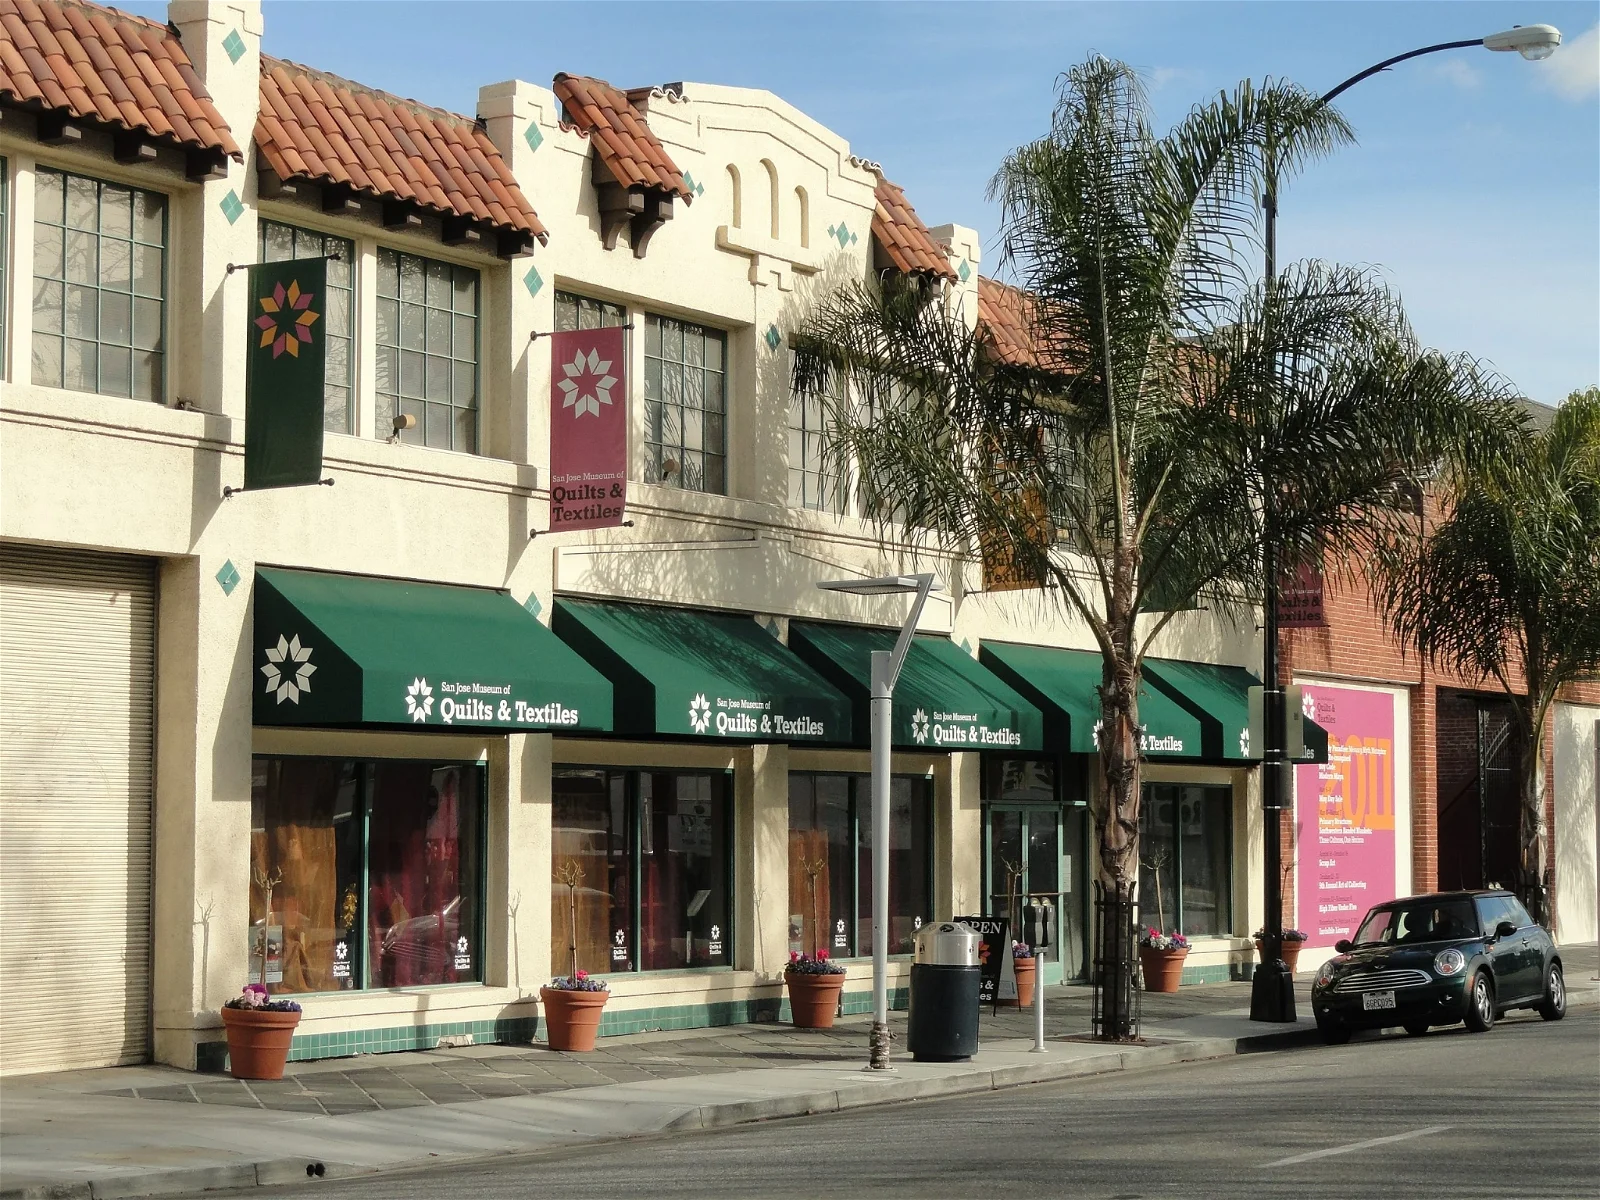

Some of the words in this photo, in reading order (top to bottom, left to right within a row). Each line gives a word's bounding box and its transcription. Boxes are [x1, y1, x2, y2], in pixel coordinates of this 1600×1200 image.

[566, 474, 581, 483] Jose
[582, 472, 615, 480] Museum
[552, 484, 606, 504] Quilts
[610, 483, 623, 498] &
[552, 504, 621, 522] Textiles
[1279, 610, 1322, 622] extiles
[441, 682, 454, 692] San
[456, 682, 470, 694] Jose
[472, 684, 502, 694] Museum
[503, 685, 512, 694] of
[440, 698, 493, 724] Quilts
[497, 700, 511, 722] &
[515, 701, 578, 724] Textiles
[717, 698, 728, 706] San
[728, 698, 740, 709] Jose
[741, 700, 764, 709] Museum
[765, 701, 770, 710] of
[716, 712, 757, 735] Quilts
[760, 714, 772, 733] &
[774, 716, 824, 736] Textiles
[933, 724, 966, 744] Quilts
[968, 726, 978, 742] &
[980, 726, 1020, 745] Textiles
[1140, 734, 1148, 750] &
[1148, 736, 1182, 752] Textiles
[985, 980, 994, 991] &
